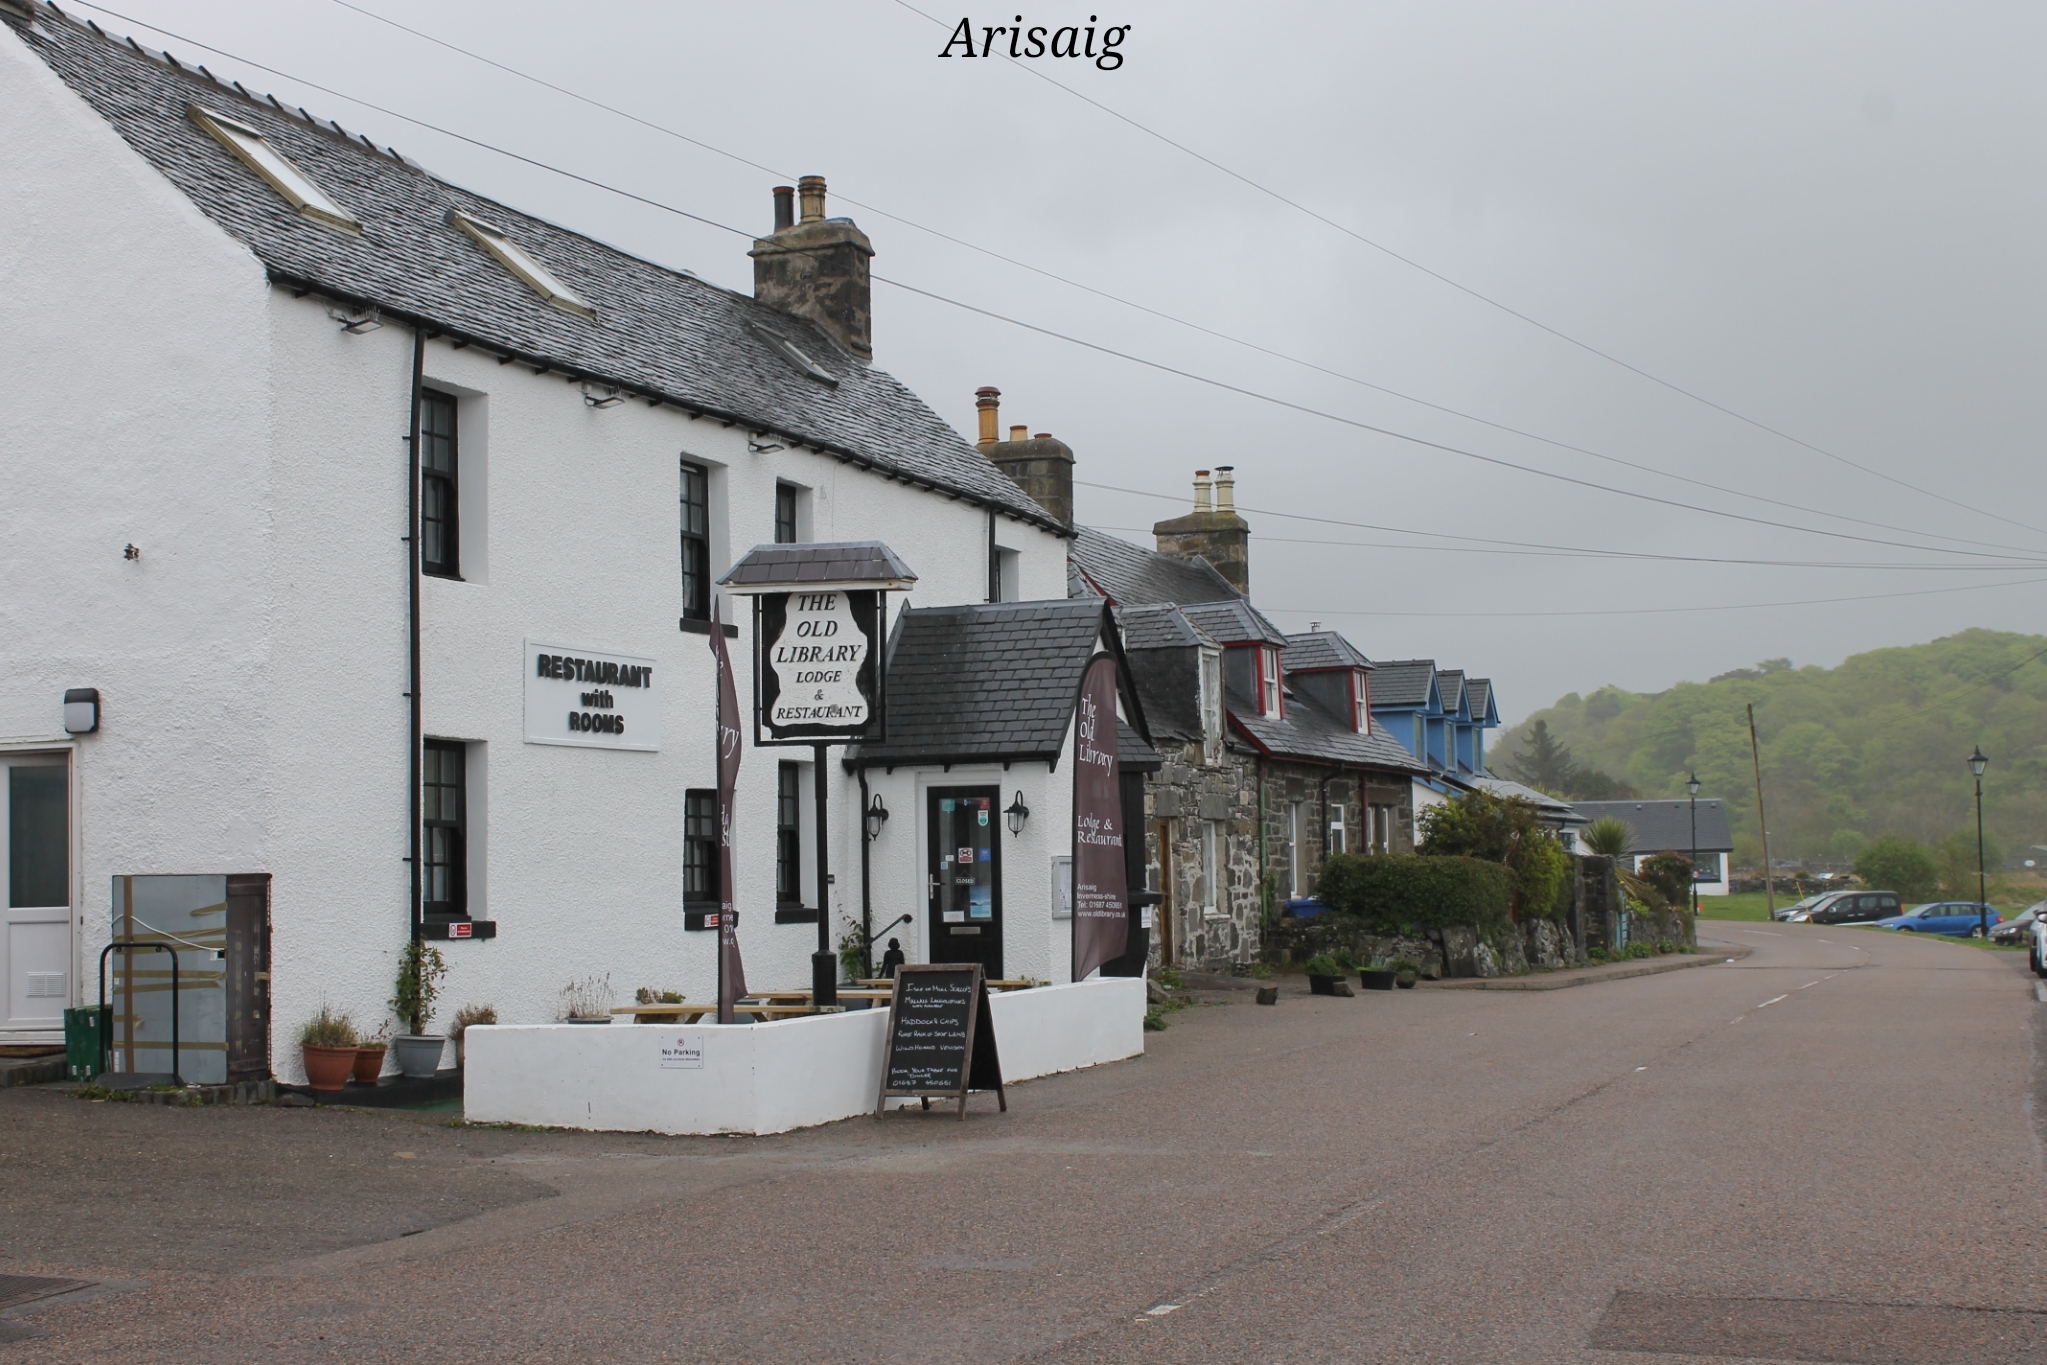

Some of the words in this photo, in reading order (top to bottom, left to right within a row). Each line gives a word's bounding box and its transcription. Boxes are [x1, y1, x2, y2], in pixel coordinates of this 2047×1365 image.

[798, 594, 837, 611] THE
[796, 620, 838, 637] OLD
[775, 644, 862, 663] LIBRARY
[537, 653, 652, 688] RESTAURANT
[795, 670, 842, 683] LODGE
[581, 688, 614, 708] with
[814, 689, 824, 700] &
[776, 705, 863, 719] RESTAURANT
[1081, 693, 1097, 718] The
[568, 711, 624, 734] ROOMS
[1080, 717, 1095, 741] Old
[1079, 740, 1113, 777] Library
[1103, 818, 1113, 831] &
[1077, 830, 1122, 847] Restaurant
[1076, 892, 1116, 900] Inverness-shire
[1077, 883, 1097, 892] Arisaig
[1089, 901, 1105, 909] 01687
[674, 1049, 700, 1057] Parking
